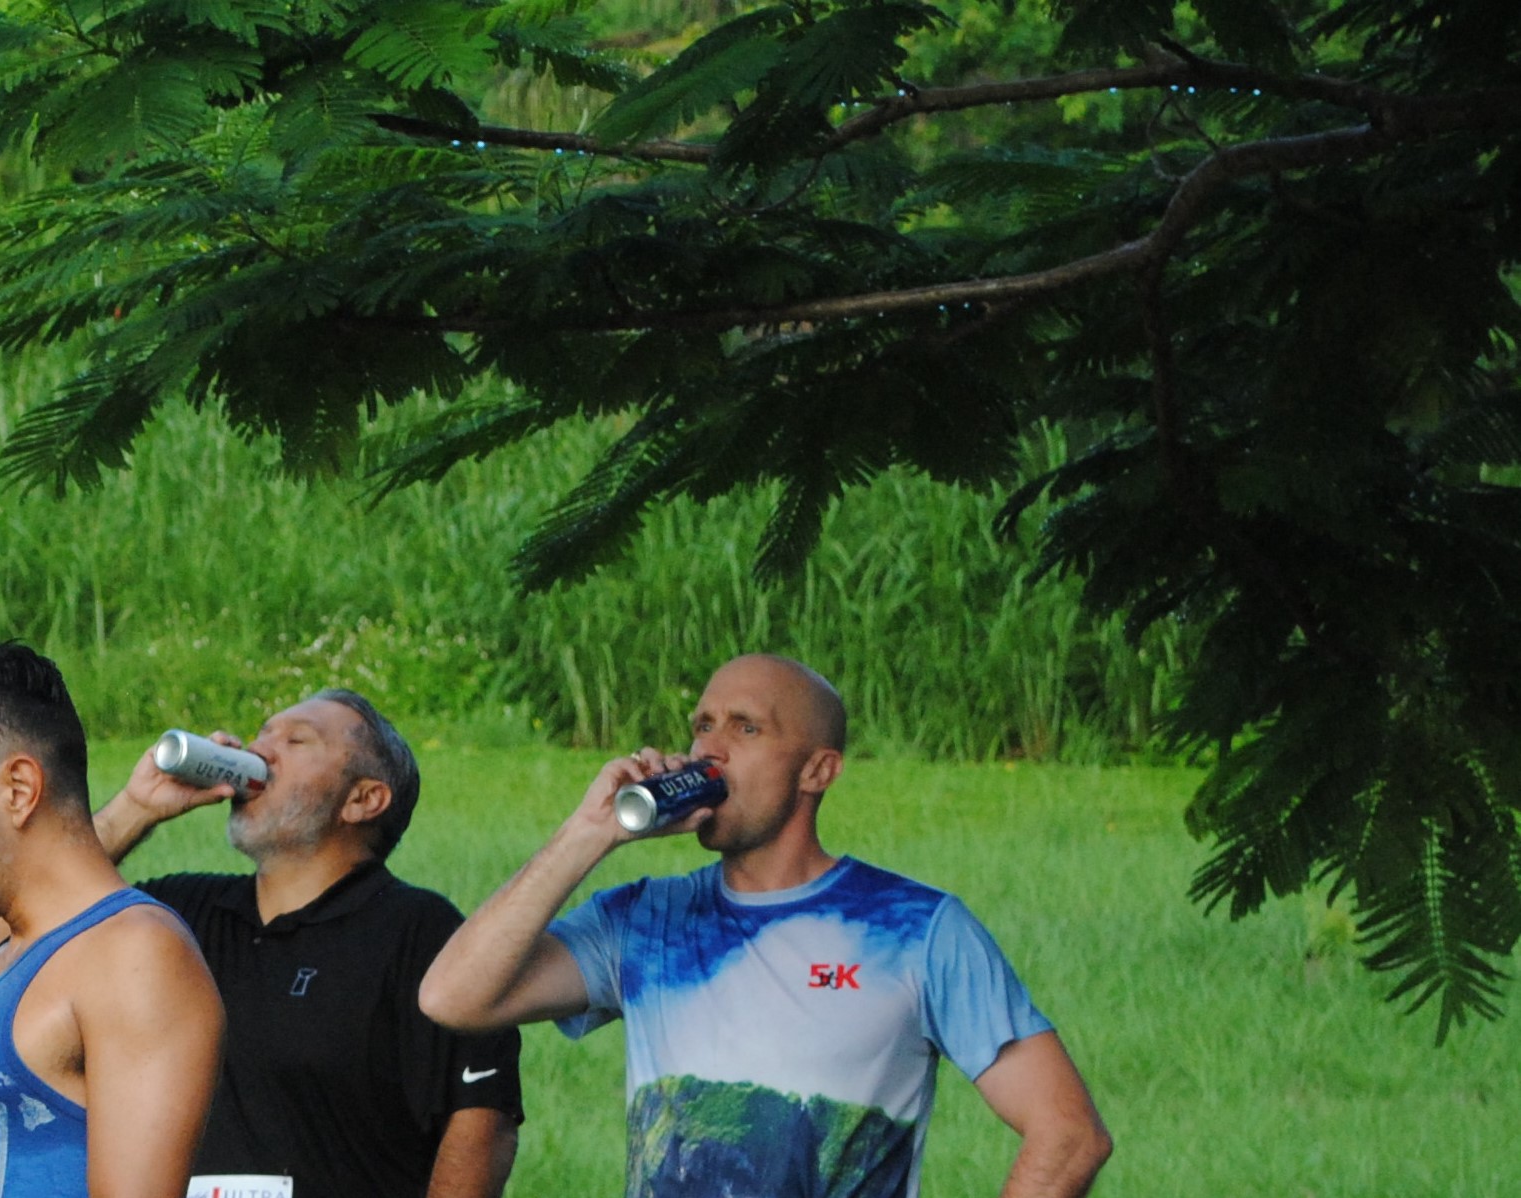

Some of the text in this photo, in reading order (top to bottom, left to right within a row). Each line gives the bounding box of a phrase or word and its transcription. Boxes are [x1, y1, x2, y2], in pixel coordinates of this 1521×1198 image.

[196, 762, 243, 785] ULTRA
[659, 770, 707, 797] ULTRA
[808, 963, 862, 990] 5K
